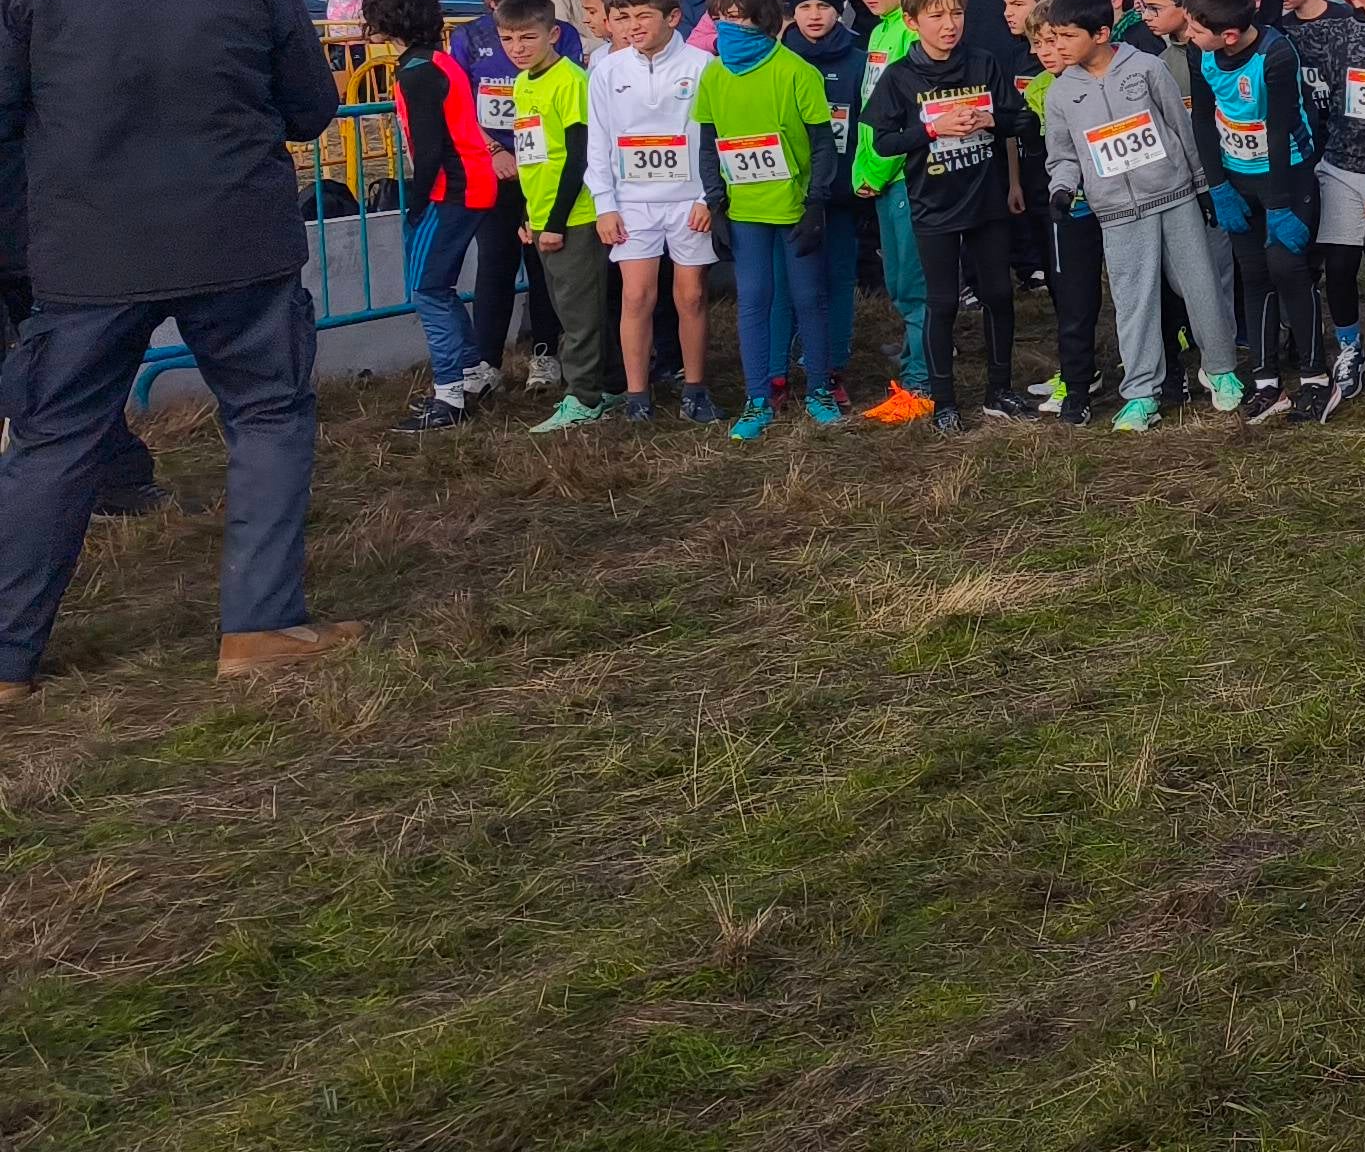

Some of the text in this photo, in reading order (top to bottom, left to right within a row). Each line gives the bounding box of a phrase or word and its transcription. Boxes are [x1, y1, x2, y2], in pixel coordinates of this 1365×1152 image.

[480, 76, 517, 86] Emir
[515, 131, 535, 153] 24
[1100, 127, 1157, 162] 1036
[1222, 128, 1259, 150] 298
[634, 149, 678, 169] 308
[735, 149, 776, 171] 316
